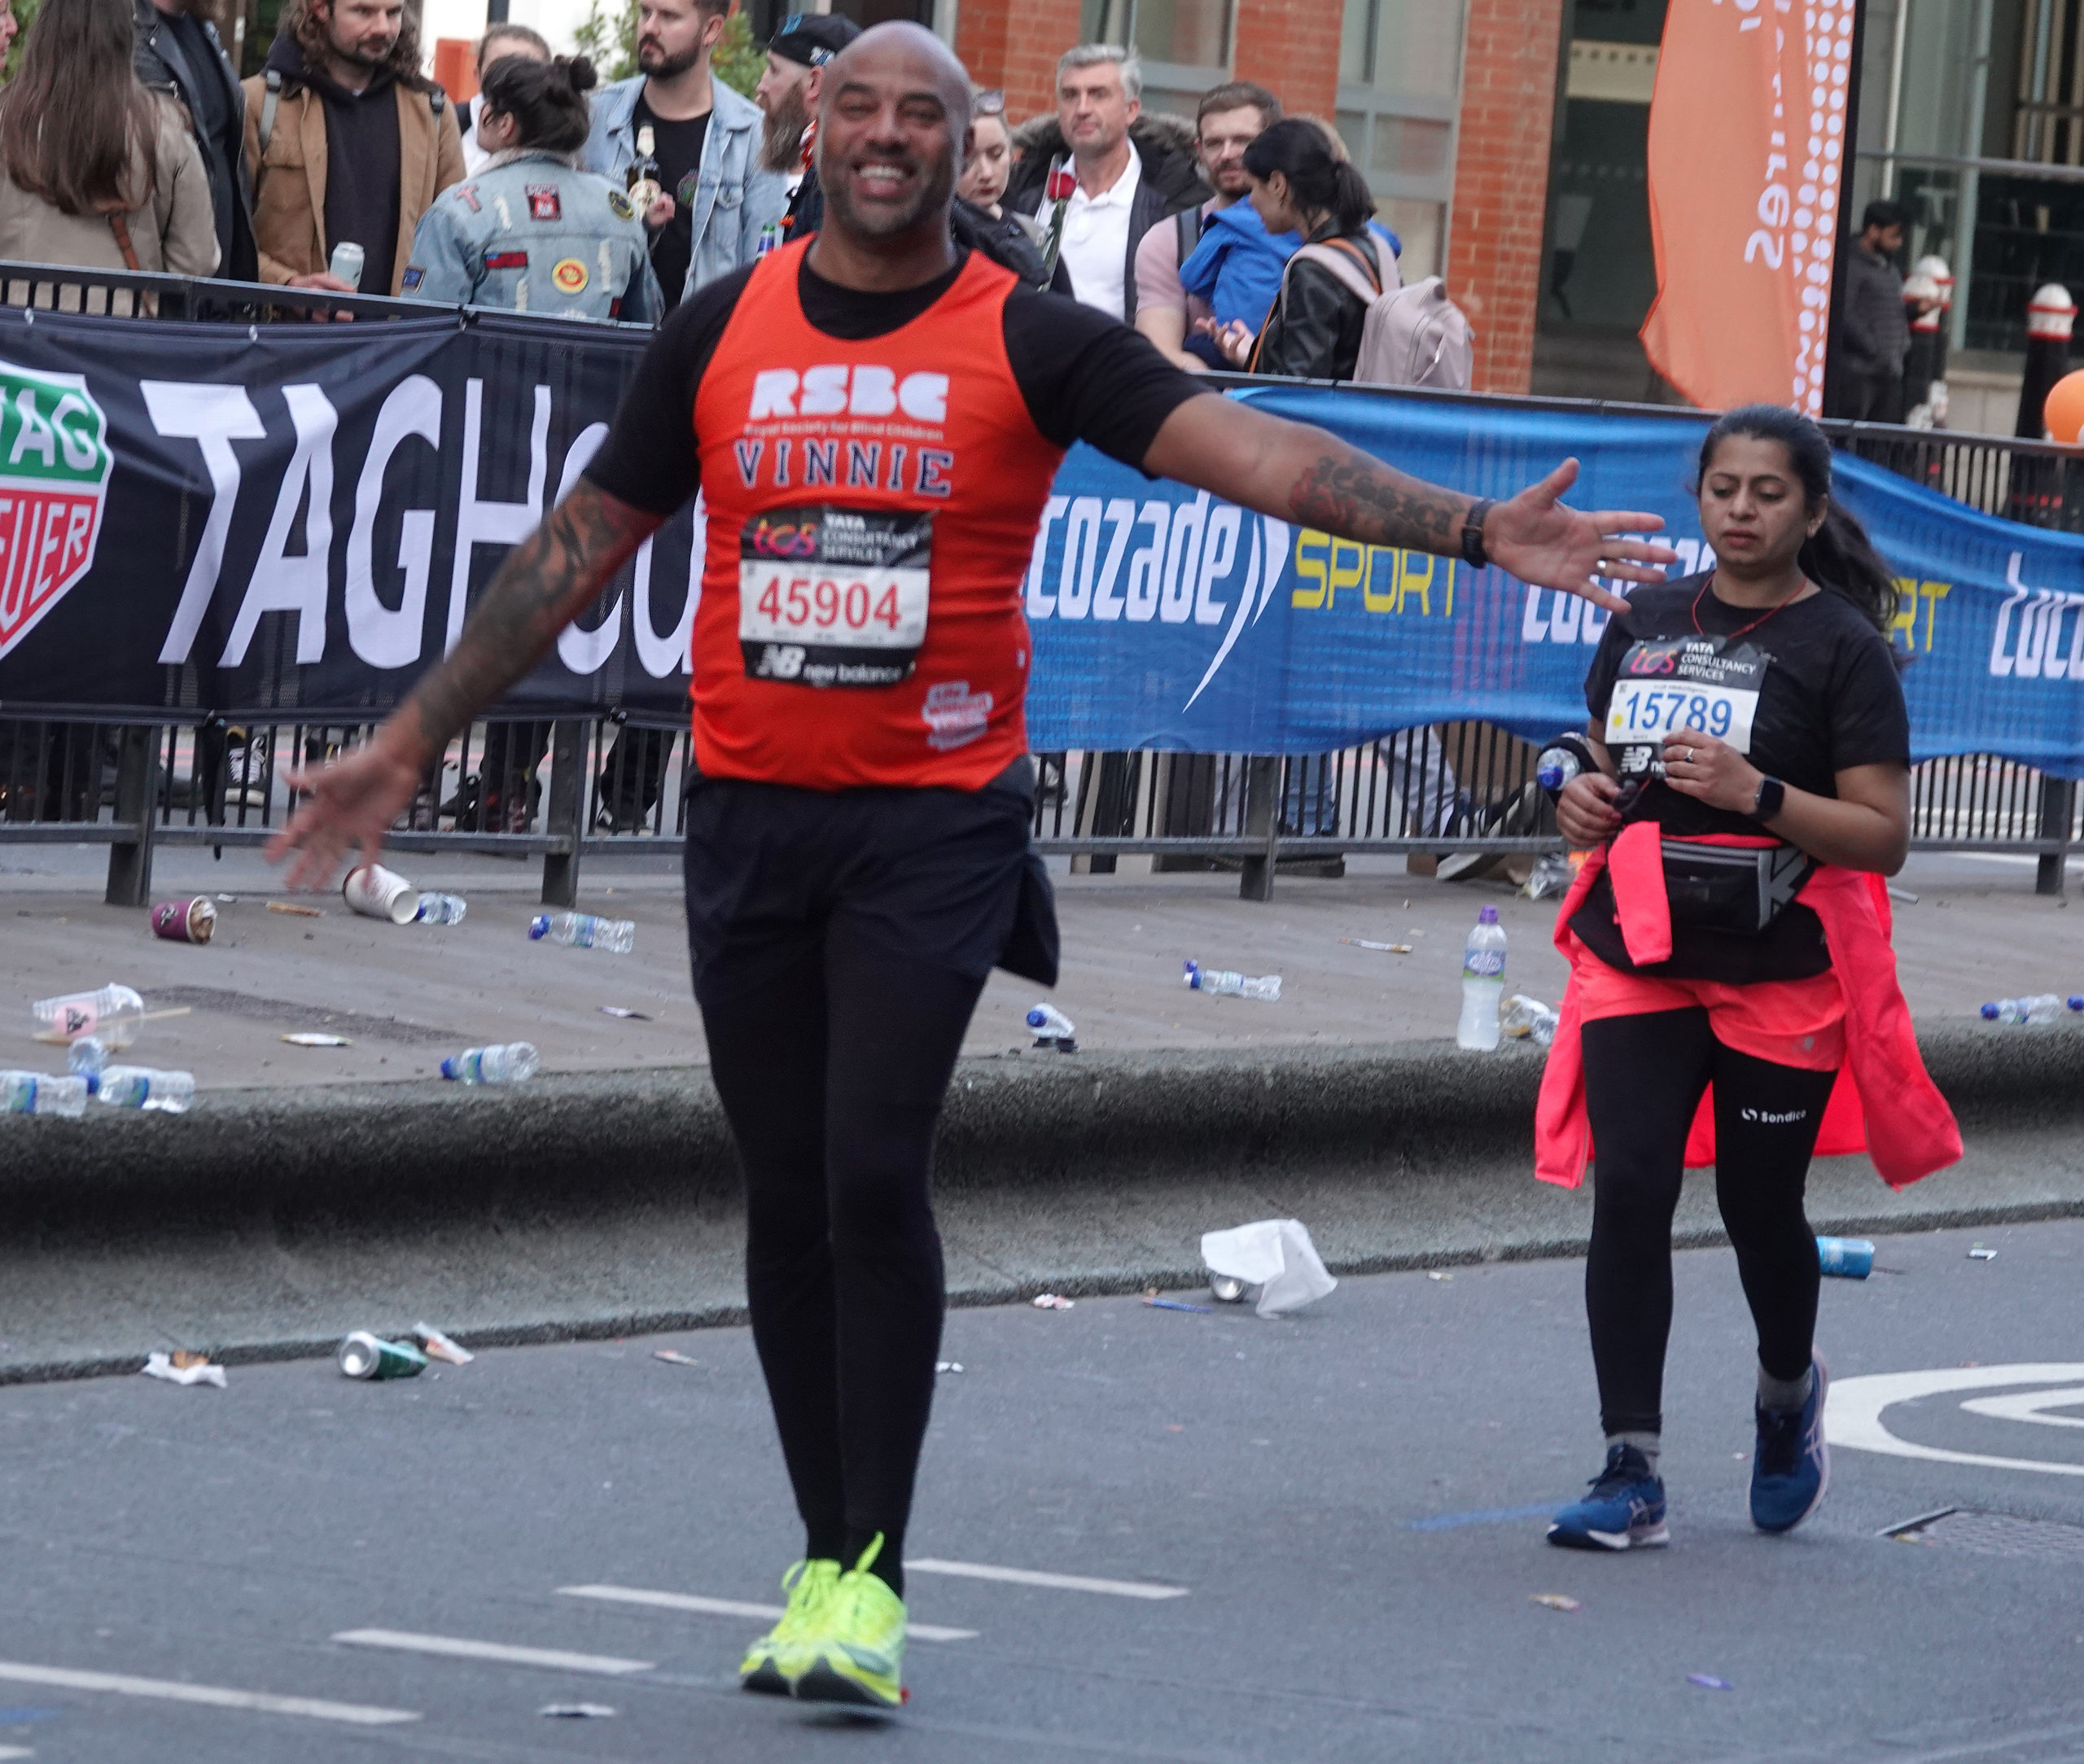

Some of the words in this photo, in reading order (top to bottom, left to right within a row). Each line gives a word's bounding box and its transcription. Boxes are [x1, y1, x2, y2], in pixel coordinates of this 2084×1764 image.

[748, 363, 950, 423] RSBC
[735, 437, 954, 498] VINNIE
[1018, 488, 1243, 626] cozade
[757, 576, 901, 632] 45904
[1677, 663, 1726, 681] SERVICES
[1680, 653, 1758, 675] CONSULTANCY
[1685, 641, 1714, 655] TATA
[1626, 692, 1732, 738] 15789
